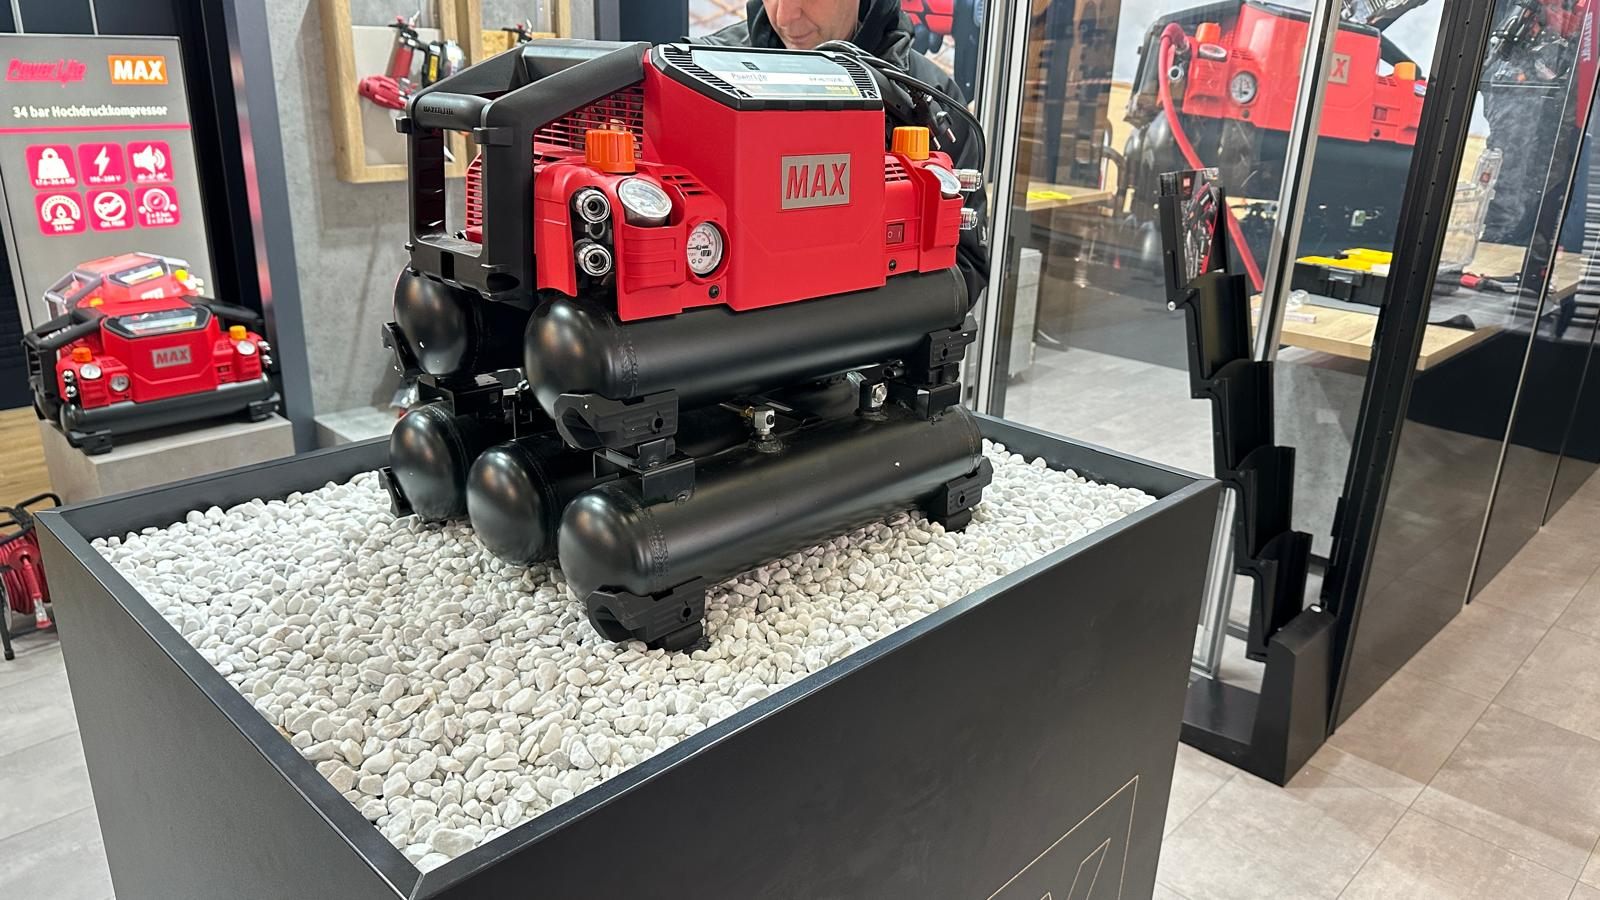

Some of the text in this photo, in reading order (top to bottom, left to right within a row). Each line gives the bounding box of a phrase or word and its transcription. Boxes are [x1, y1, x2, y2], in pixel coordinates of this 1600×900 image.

[113, 59, 164, 81] MAX
[12, 103, 168, 118] 34 bar Hochdruckkompressor
[785, 162, 848, 200] MAX
[156, 348, 190, 365] MAX
